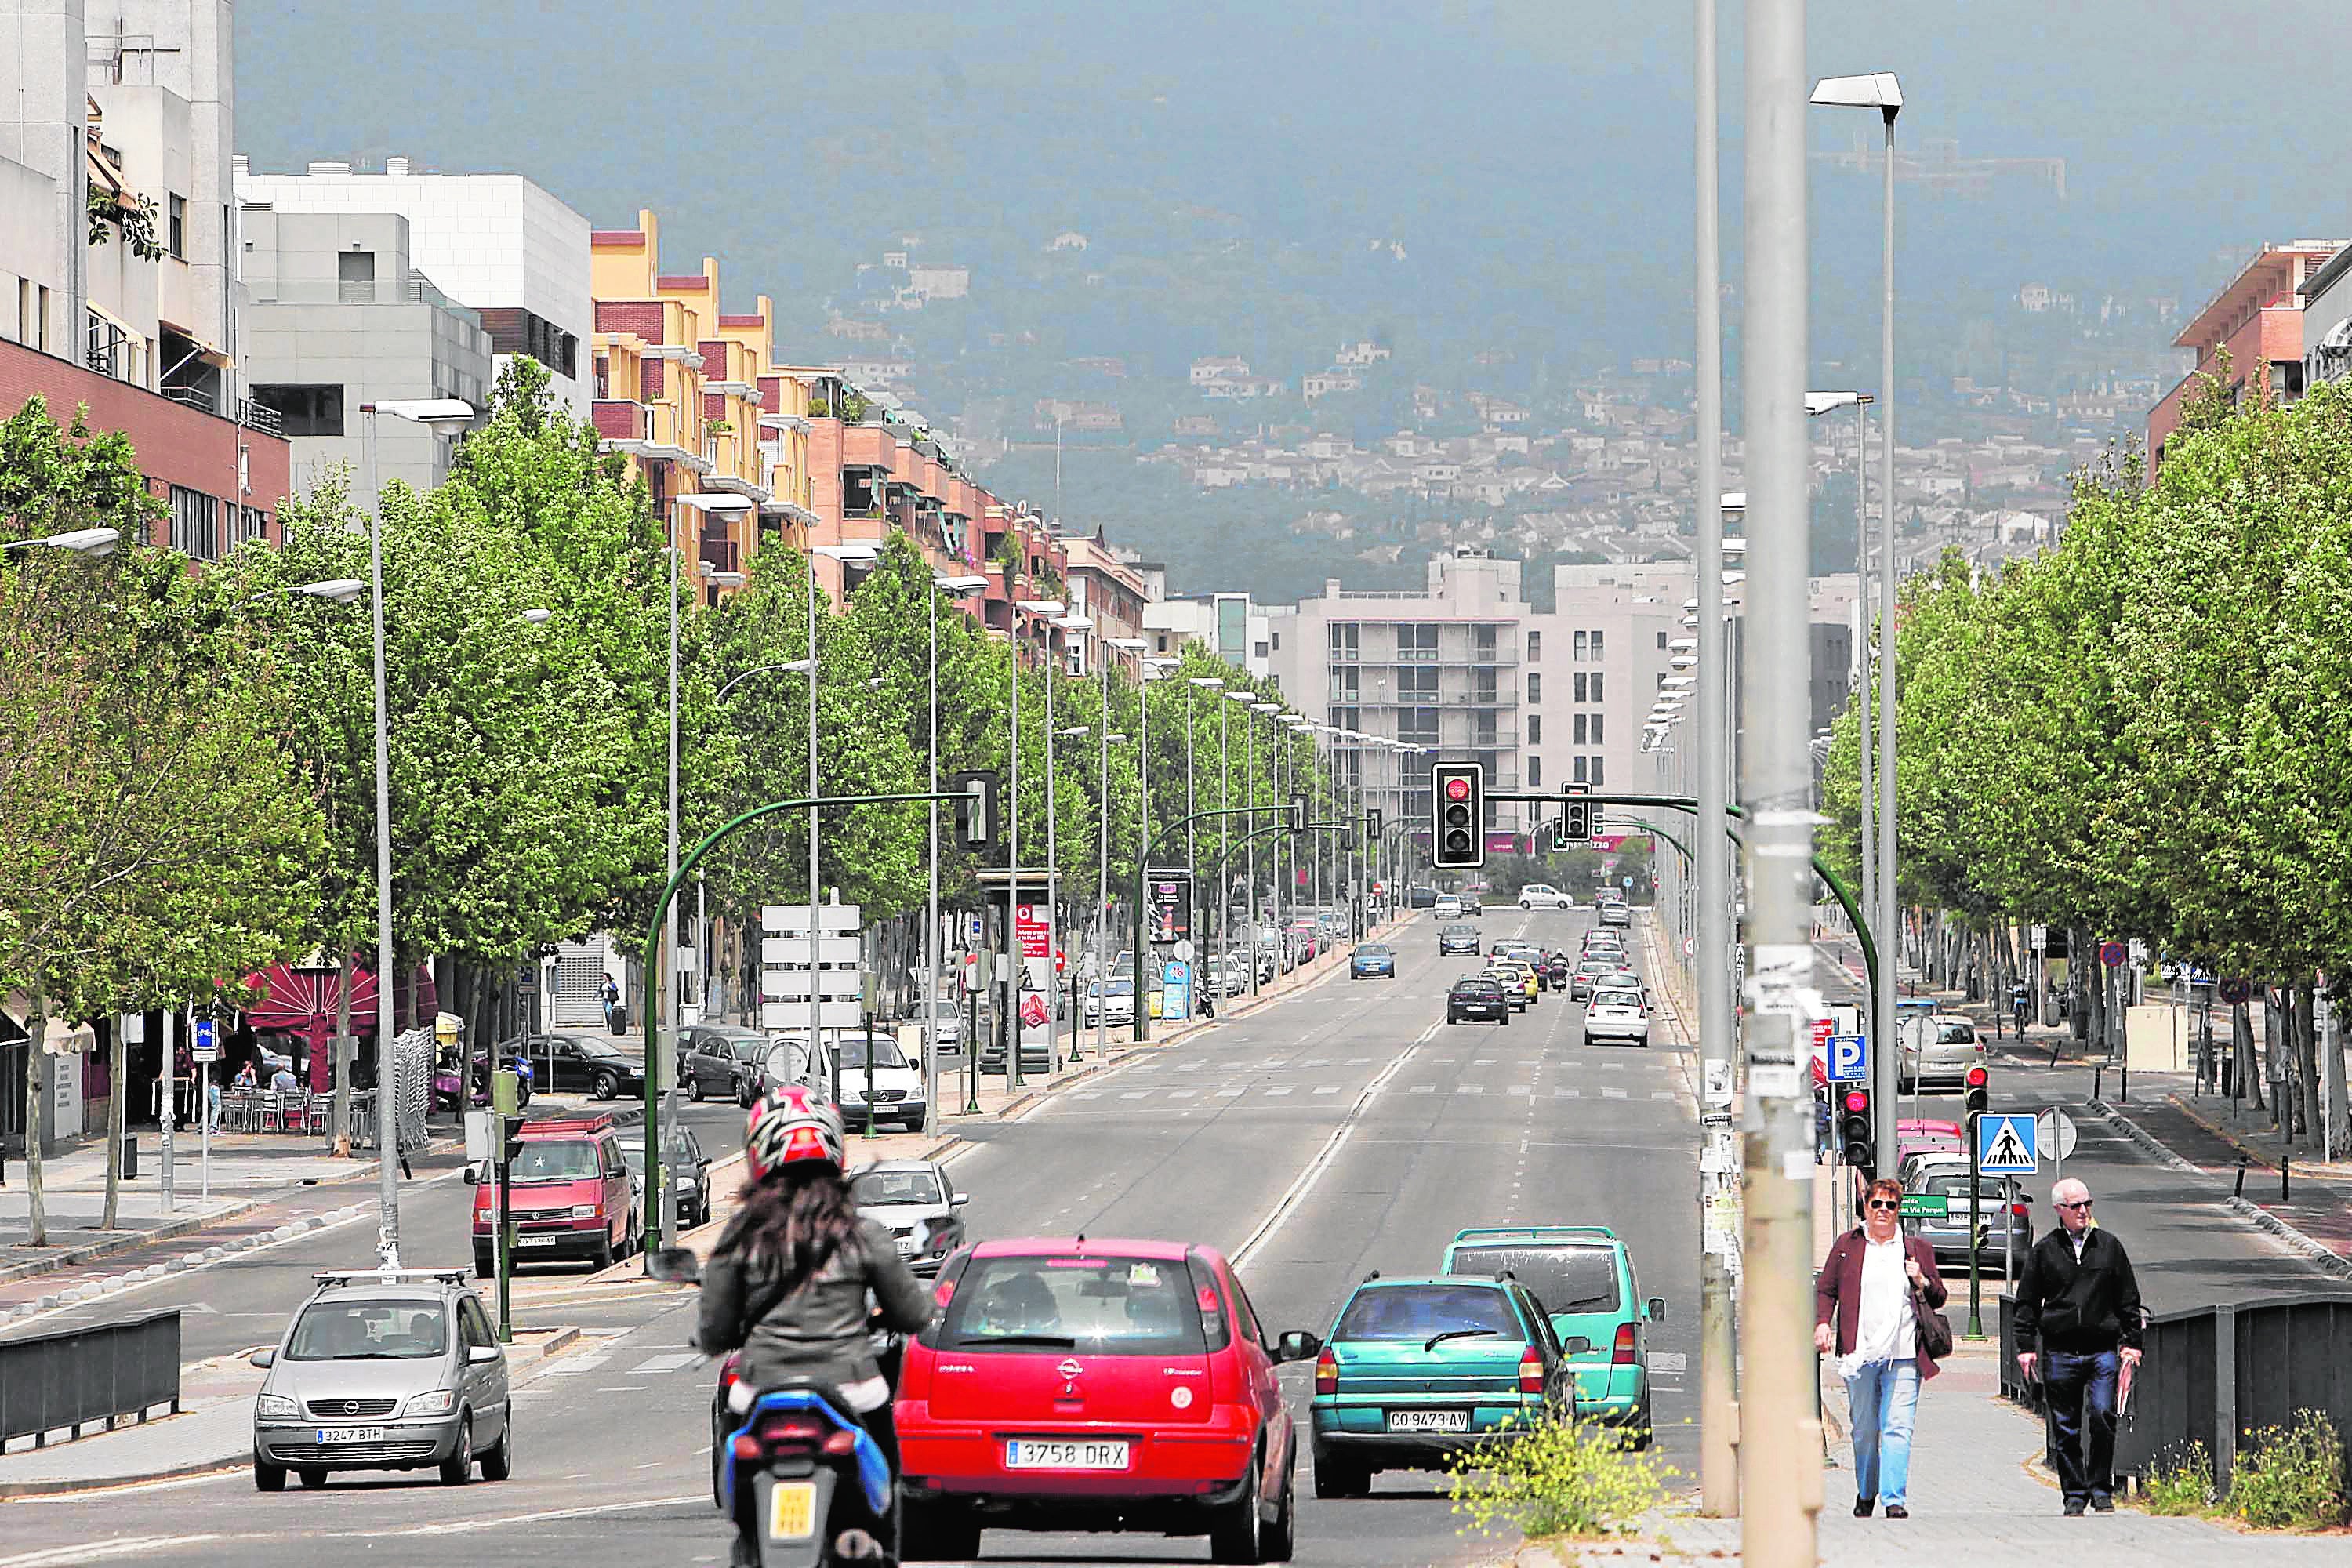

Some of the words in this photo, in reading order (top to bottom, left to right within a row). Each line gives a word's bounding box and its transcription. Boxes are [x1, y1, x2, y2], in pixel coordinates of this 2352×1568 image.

[1835, 1042, 1860, 1076] P
[325, 1430, 354, 1441] 3247
[358, 1428, 380, 1440] BTH
[1025, 1444, 1076, 1463] 3758
[1086, 1446, 1123, 1465] DRX
